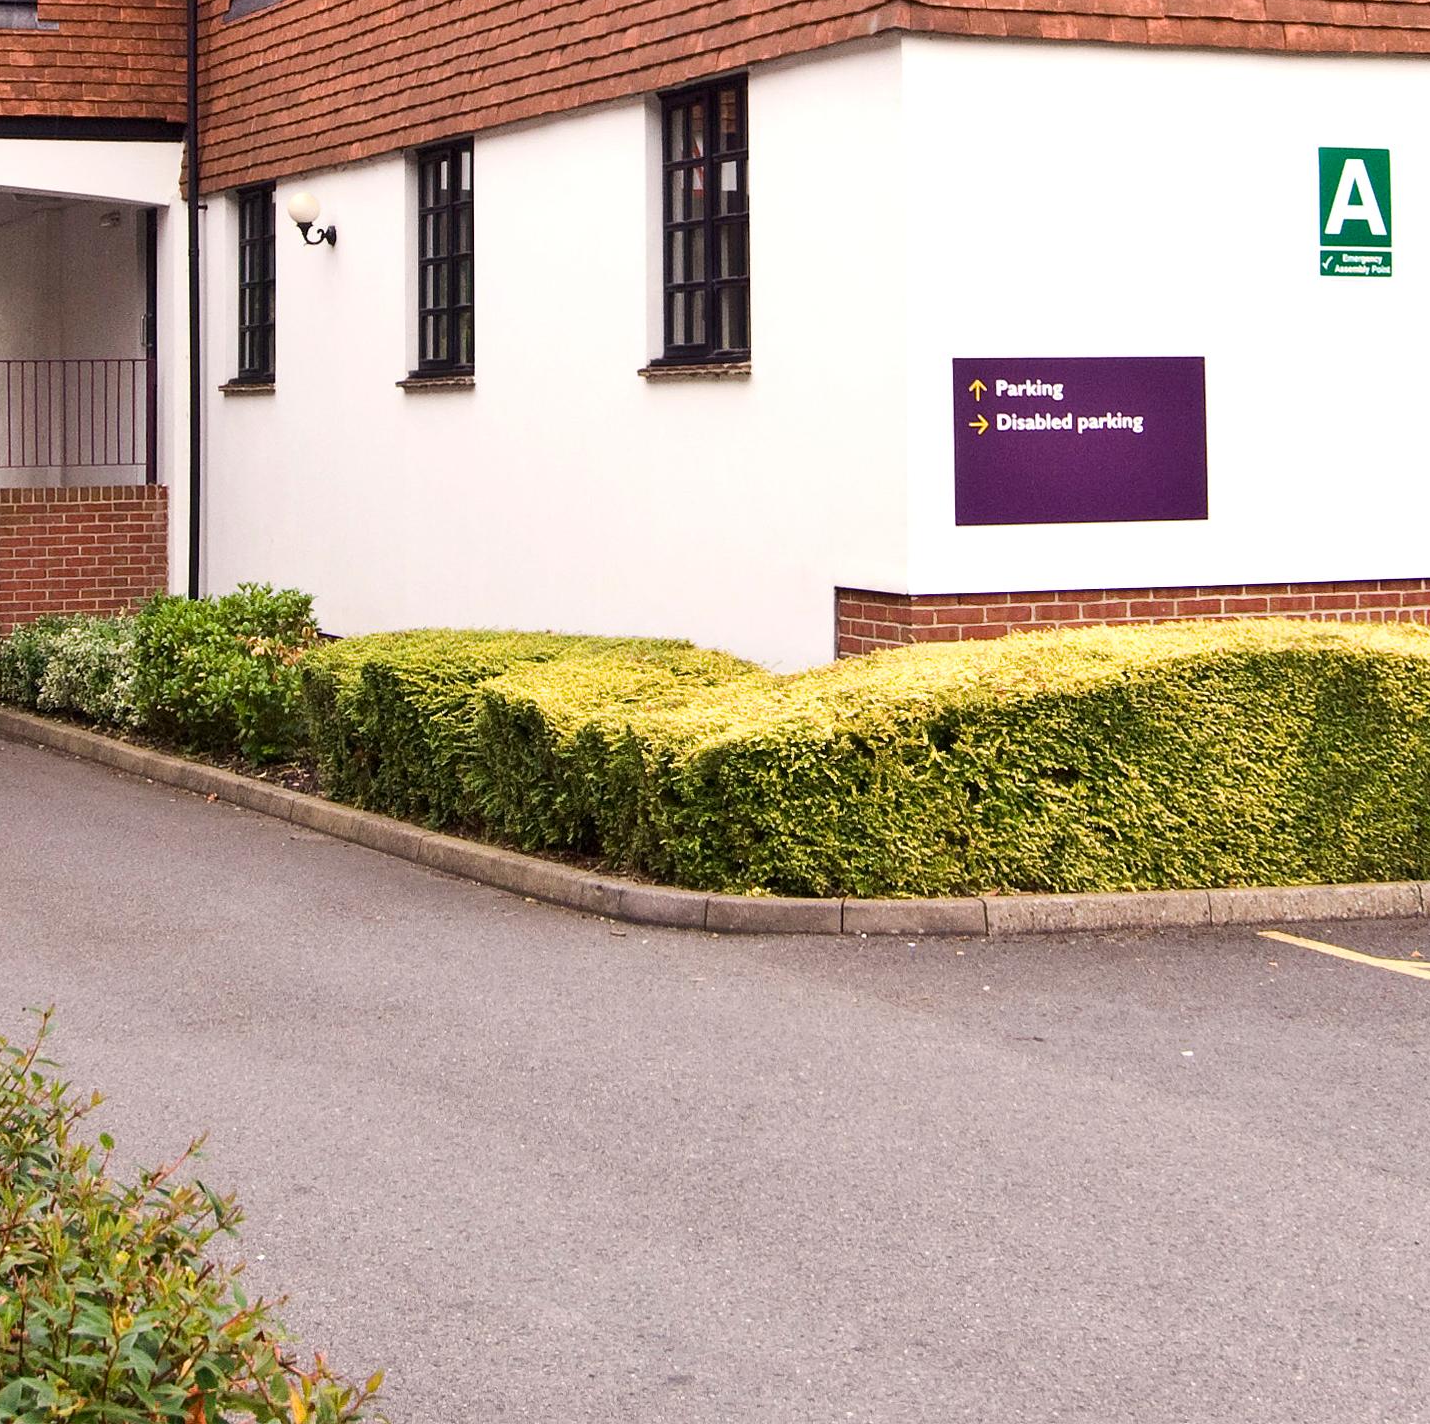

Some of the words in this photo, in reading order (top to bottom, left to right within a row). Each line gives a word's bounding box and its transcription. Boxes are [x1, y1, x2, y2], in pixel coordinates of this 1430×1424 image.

[1324, 158, 1388, 236] A
[995, 379, 1064, 400] Parking
[996, 413, 1073, 431] Disabled
[1078, 412, 1144, 434] parking
